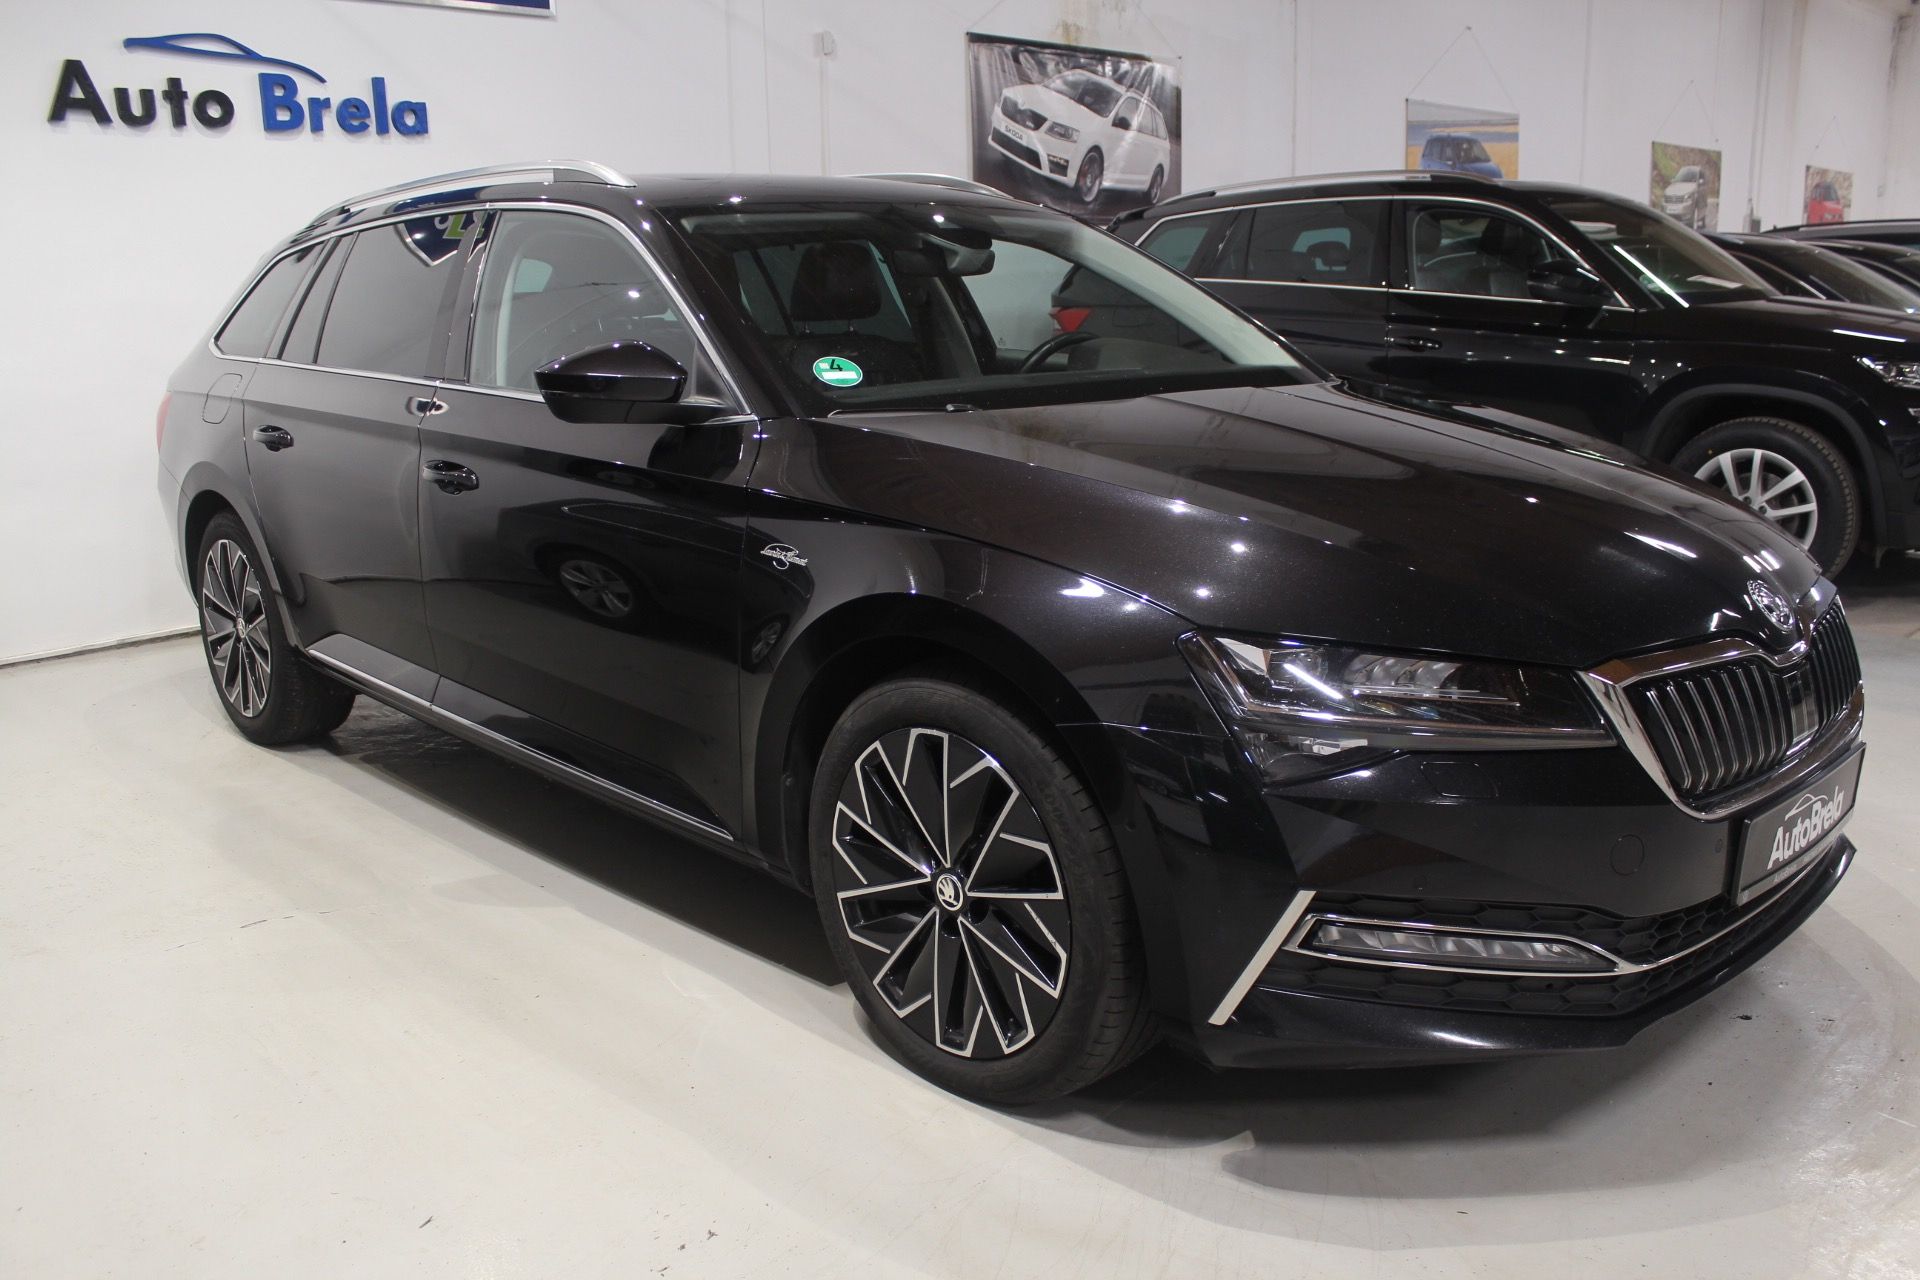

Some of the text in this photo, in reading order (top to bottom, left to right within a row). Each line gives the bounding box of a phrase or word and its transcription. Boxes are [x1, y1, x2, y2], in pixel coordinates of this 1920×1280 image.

[48, 59, 429, 136] Auto Brela
[830, 359, 843, 371] 4
